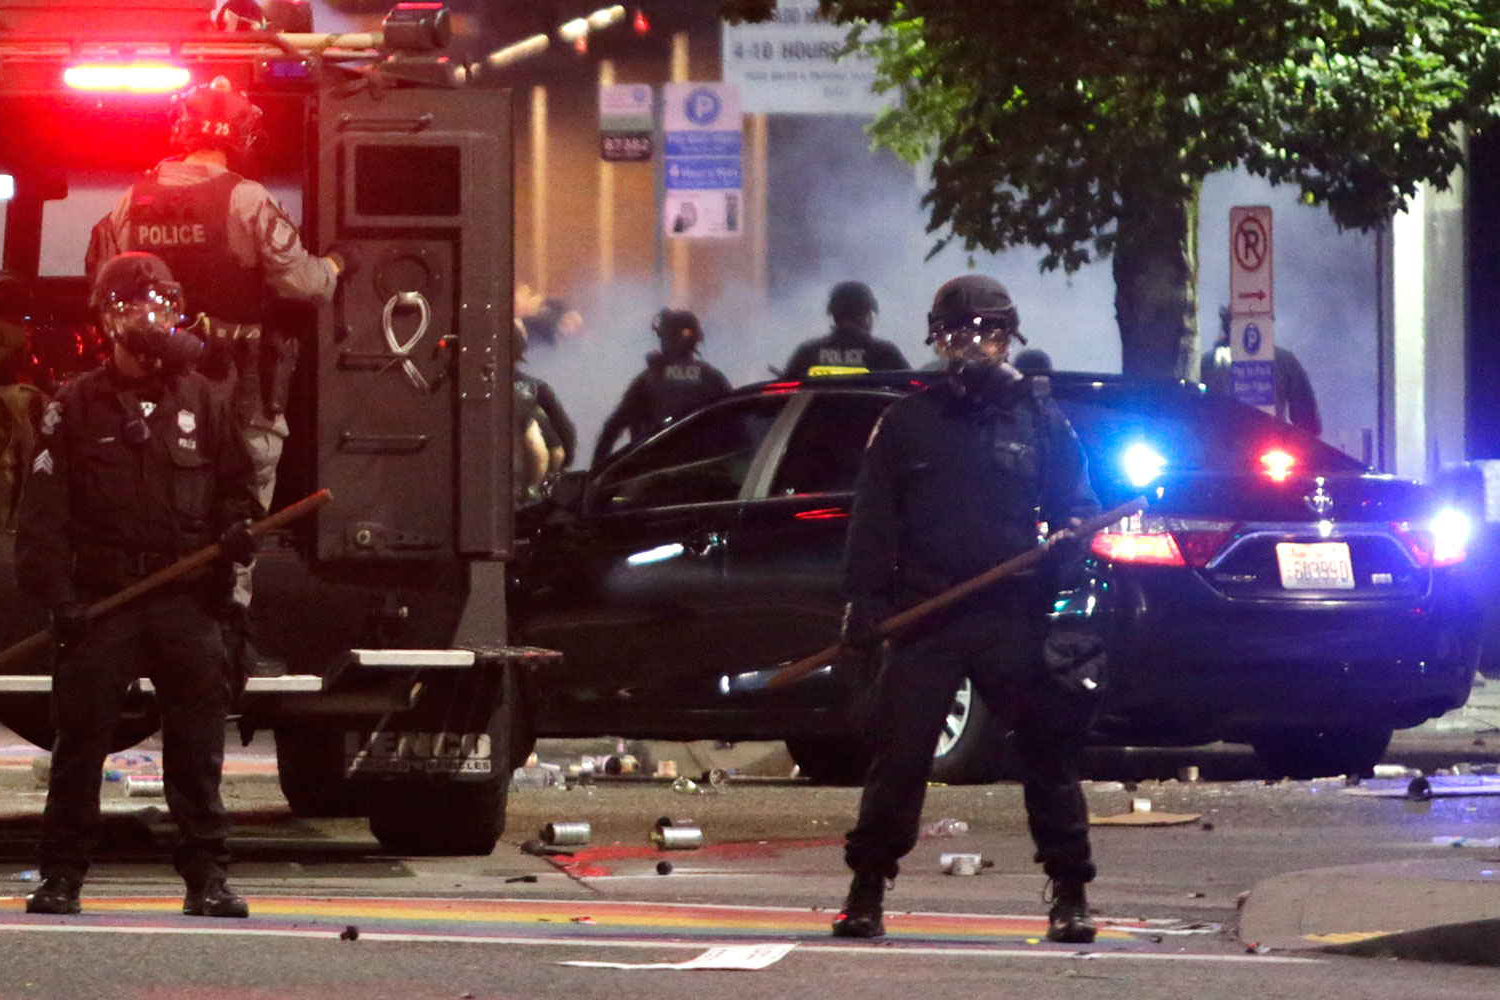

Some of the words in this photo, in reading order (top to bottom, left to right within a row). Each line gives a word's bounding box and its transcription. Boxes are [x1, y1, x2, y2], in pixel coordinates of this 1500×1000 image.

[139, 224, 205, 245] POLICE
[665, 364, 701, 380] POLICE
[344, 731, 491, 759] LENCO
[426, 759, 491, 771] VEHICLES
